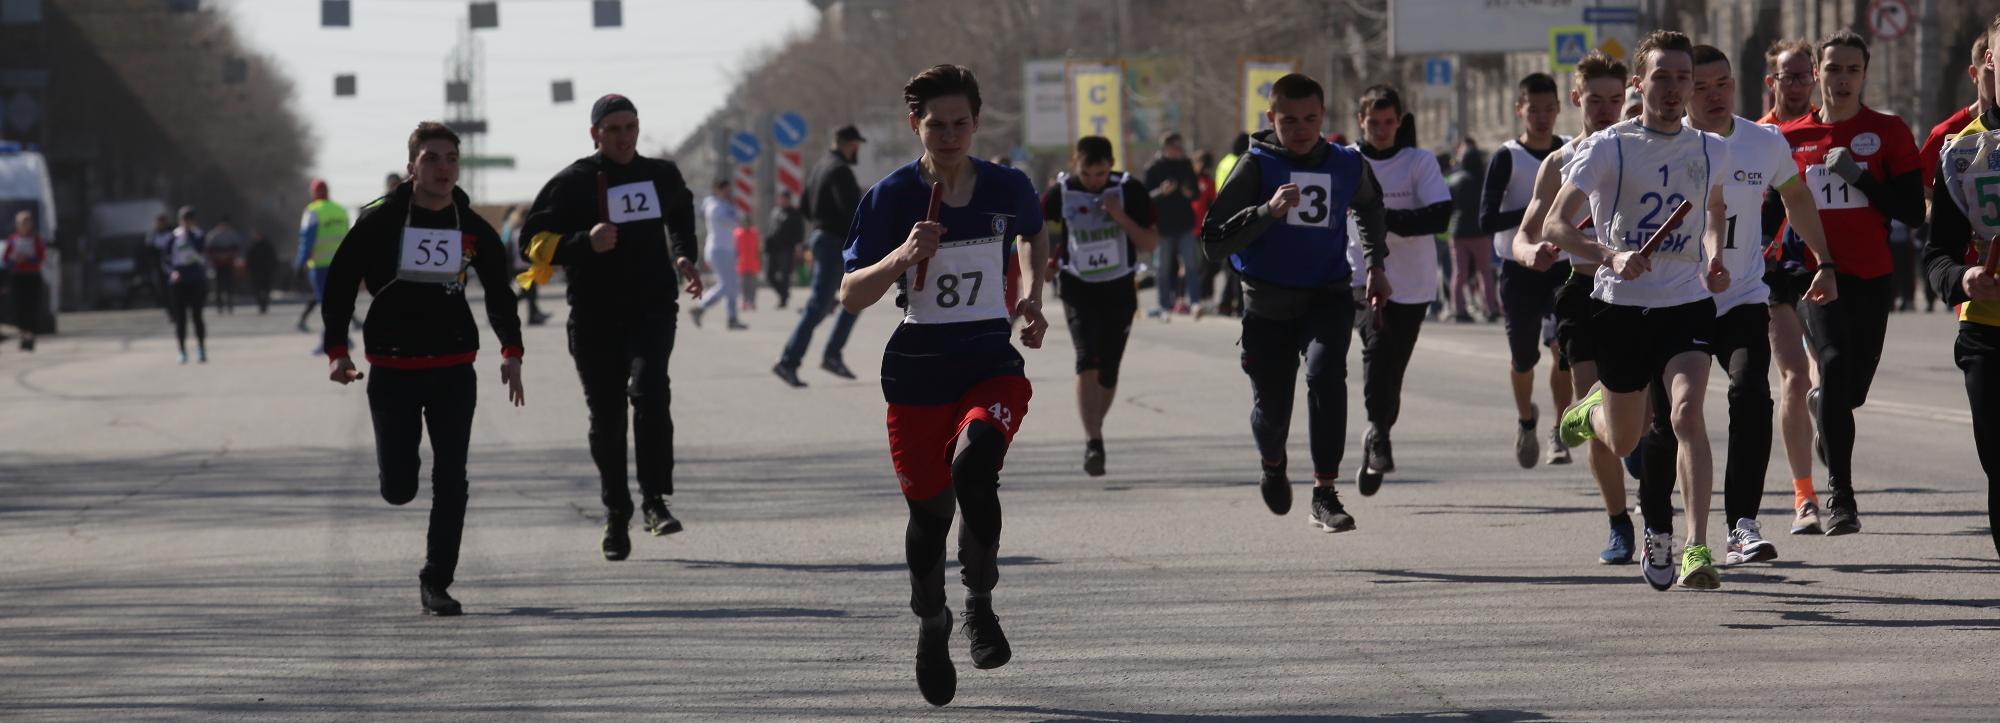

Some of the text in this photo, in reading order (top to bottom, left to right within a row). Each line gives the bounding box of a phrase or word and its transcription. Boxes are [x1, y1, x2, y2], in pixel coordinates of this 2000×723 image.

[1659, 164, 1668, 187] 1
[621, 193, 650, 213] 12
[1298, 184, 1328, 224] 3
[1821, 182, 1849, 204] 11
[1724, 214, 1738, 249] 1
[415, 239, 449, 266] 55
[1088, 253, 1108, 267] 44
[936, 270, 983, 308] 87
[988, 402, 1012, 432] 42
